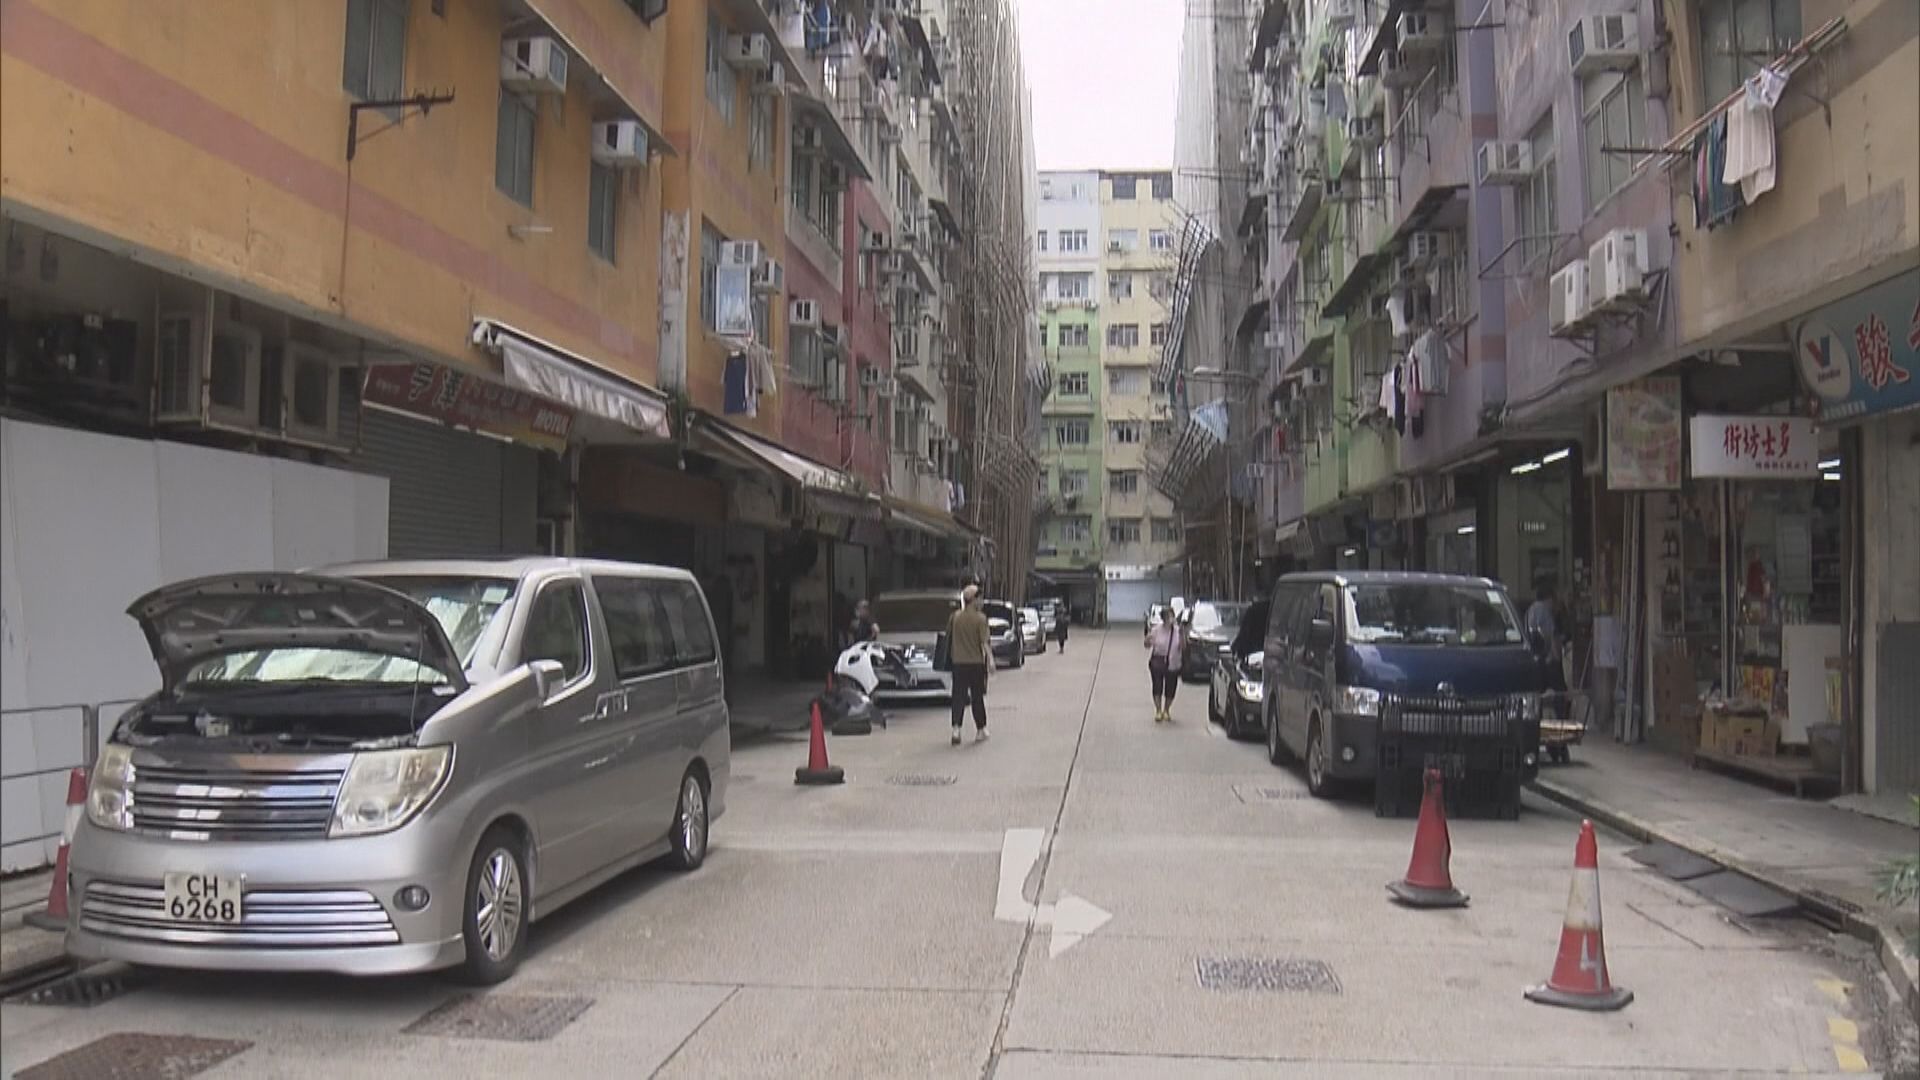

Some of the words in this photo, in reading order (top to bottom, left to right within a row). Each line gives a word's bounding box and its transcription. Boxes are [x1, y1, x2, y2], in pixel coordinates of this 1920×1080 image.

[1723, 421, 1790, 459] 街坊士多
[187, 875, 217, 897] CH
[171, 896, 234, 920] 6268
